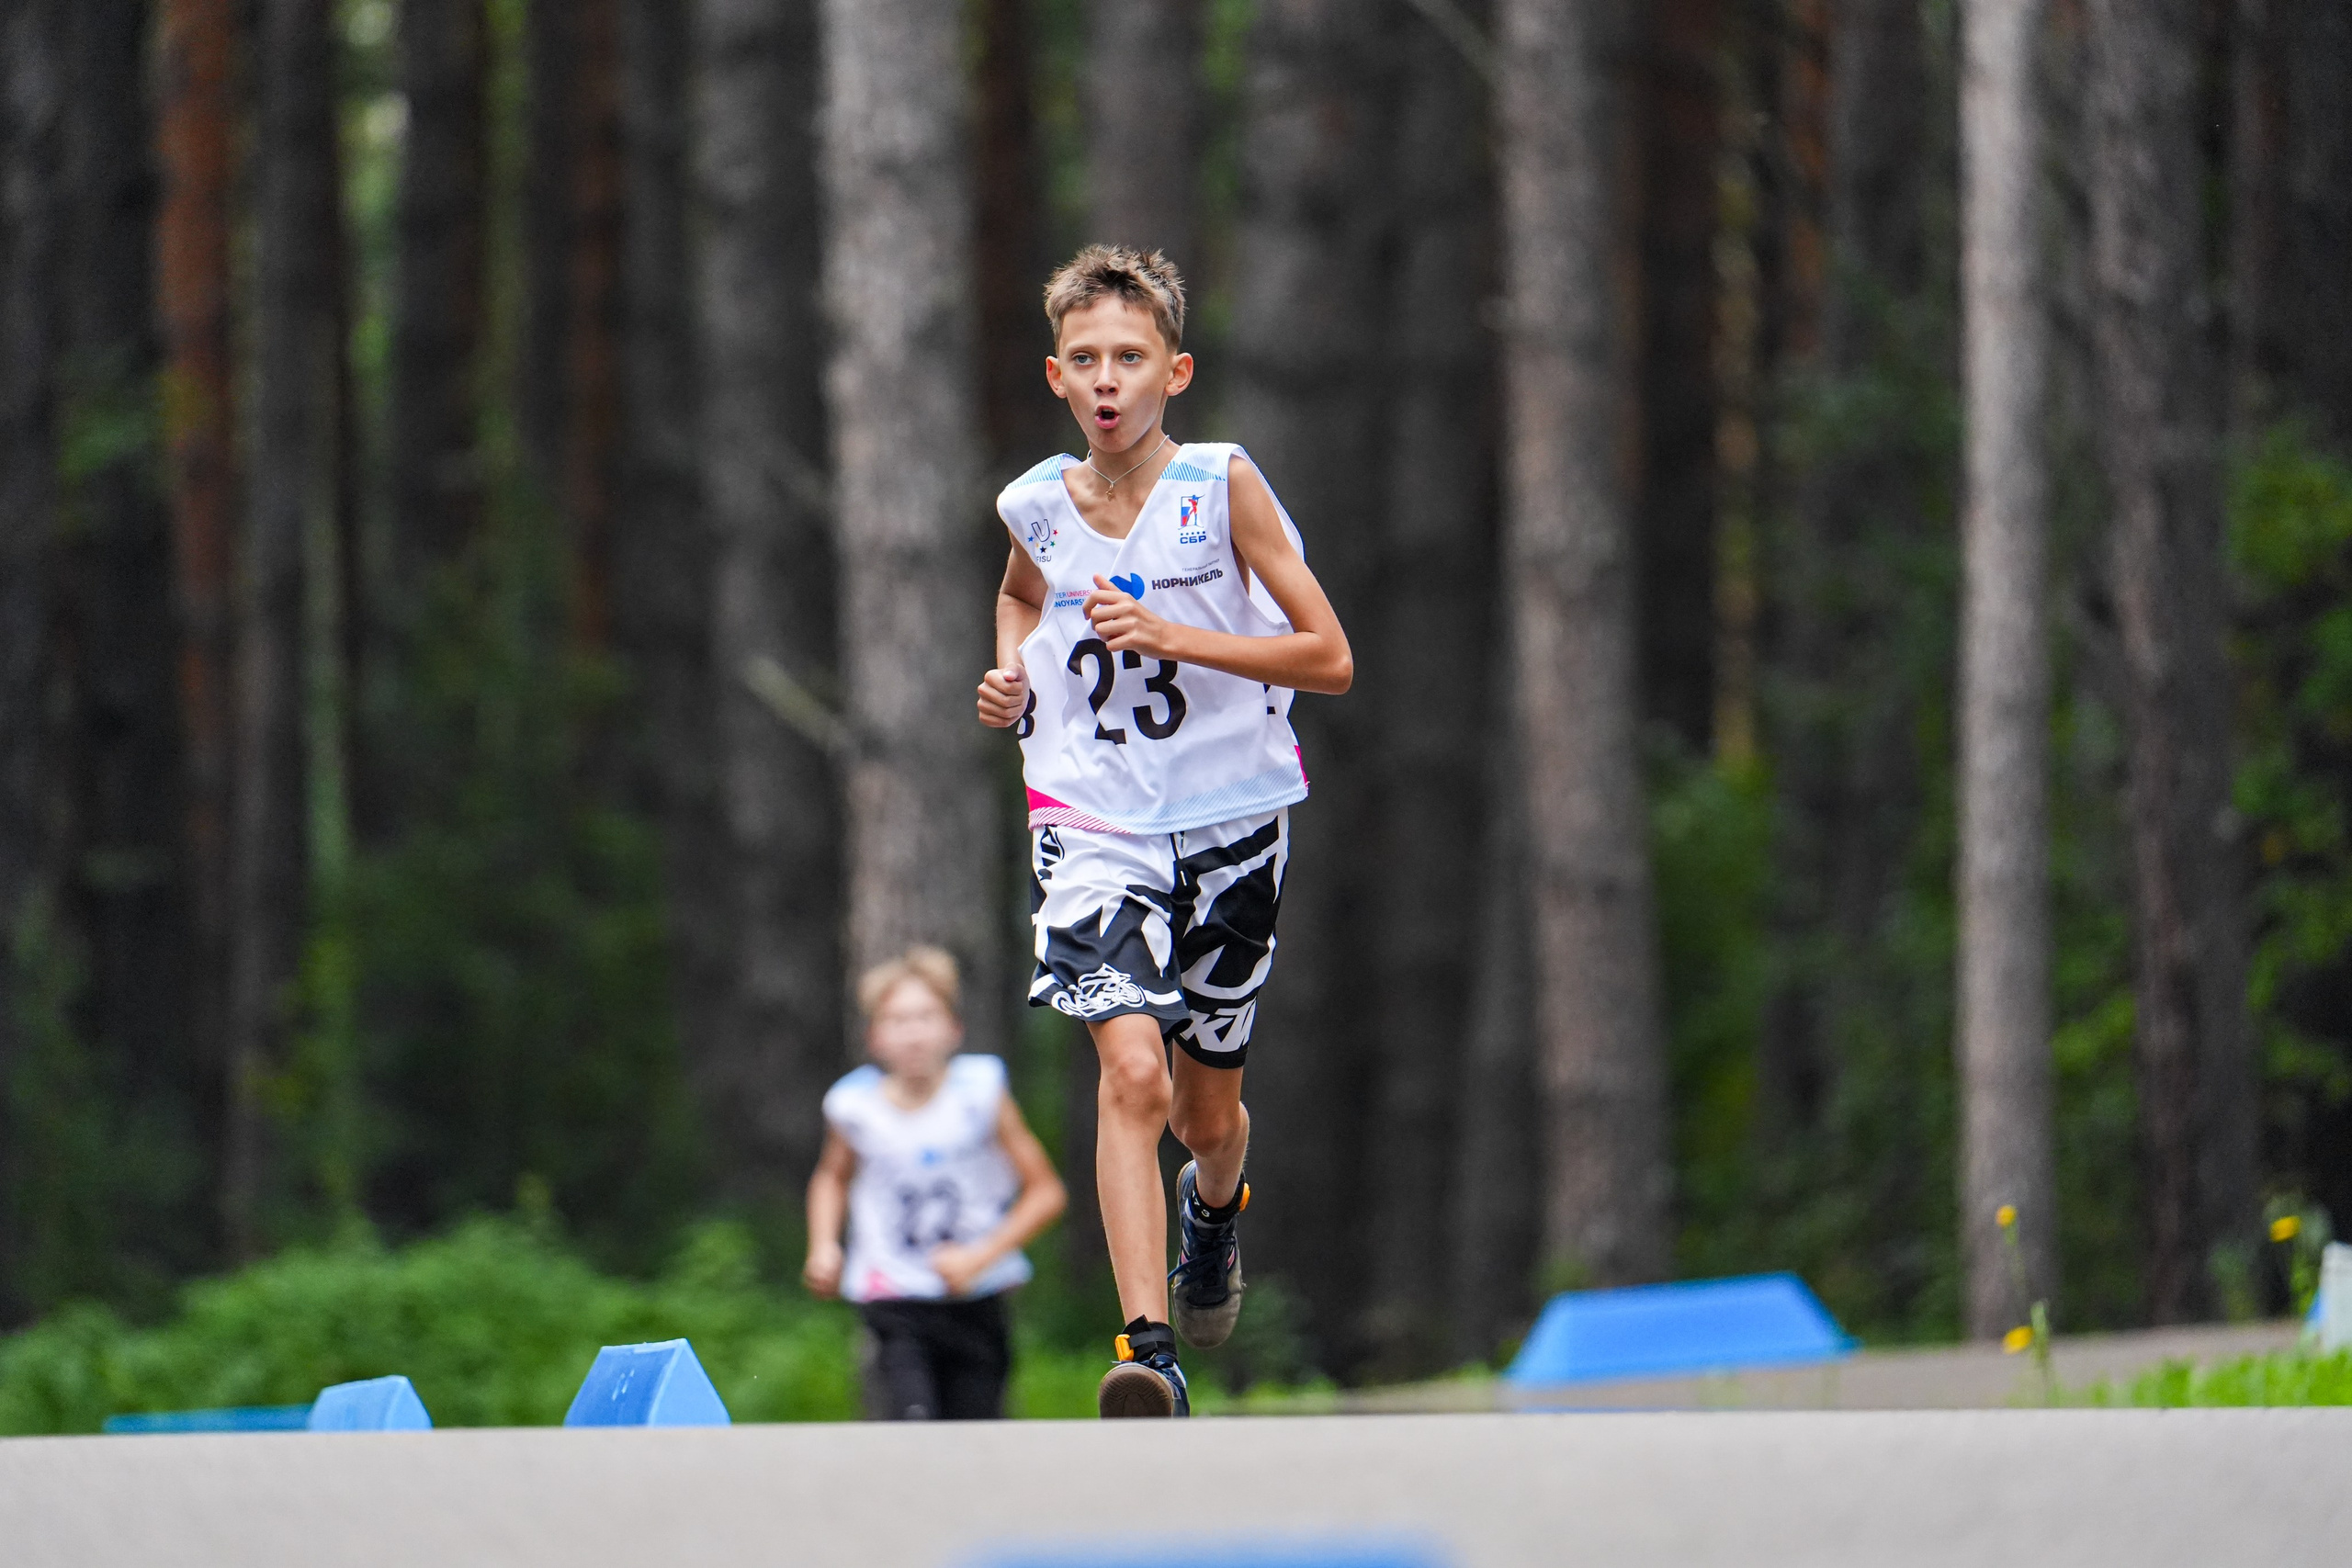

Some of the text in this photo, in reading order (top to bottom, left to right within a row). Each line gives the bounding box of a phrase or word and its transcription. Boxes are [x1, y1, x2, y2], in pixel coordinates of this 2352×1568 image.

[1180, 536, 1206, 544] СБР
[1151, 569, 1224, 590] НОРНИКЕЛЬ
[1067, 589, 1092, 598] UNIVERS
[1054, 598, 1086, 608] NOYARS
[1067, 637, 1187, 746] 23
